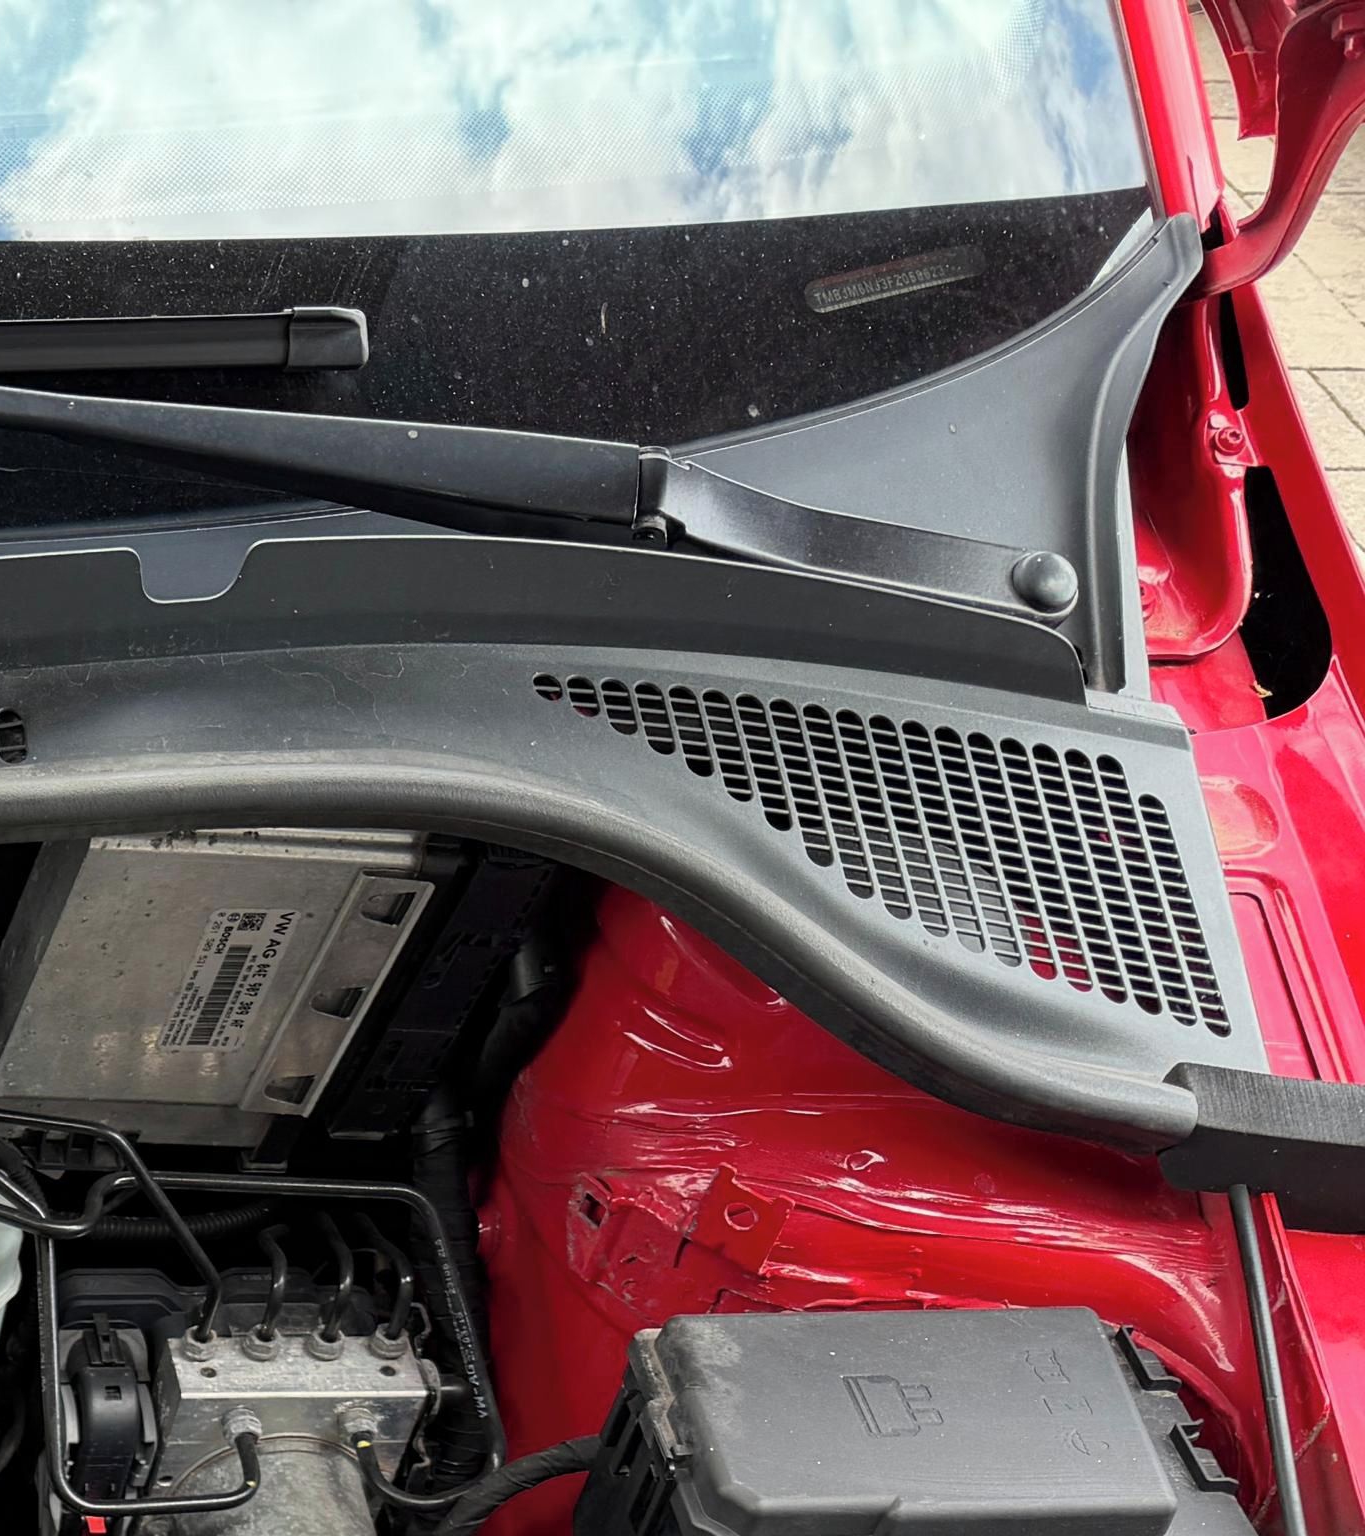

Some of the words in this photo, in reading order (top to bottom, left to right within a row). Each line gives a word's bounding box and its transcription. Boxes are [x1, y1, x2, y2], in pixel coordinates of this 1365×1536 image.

[273, 911, 295, 936] VW
[214, 925, 235, 955] BOSCH
[262, 938, 282, 959] AG
